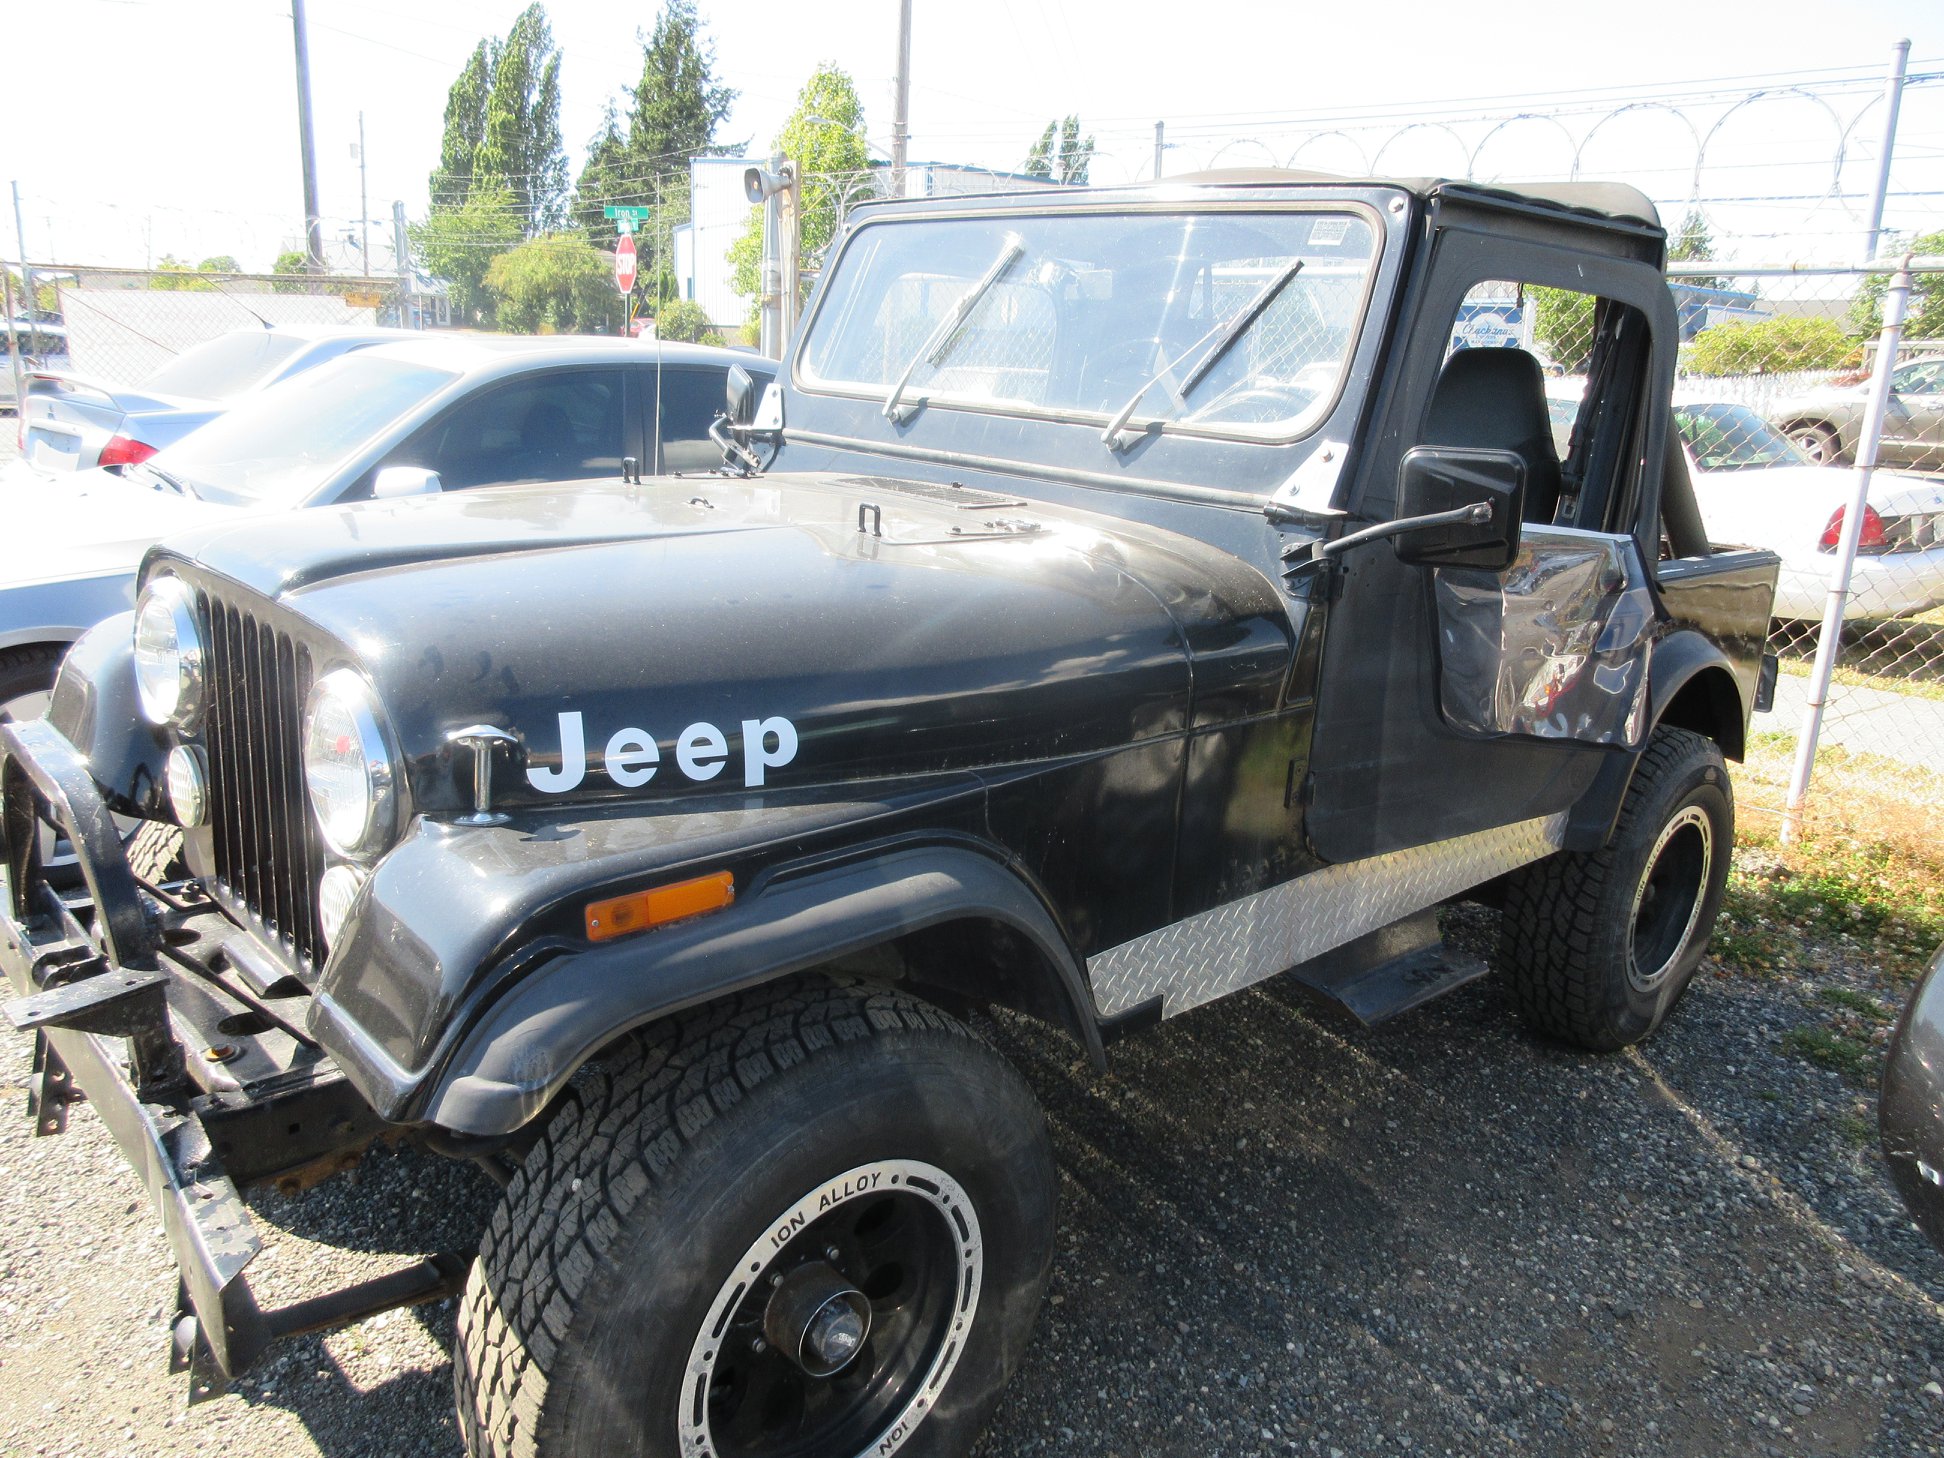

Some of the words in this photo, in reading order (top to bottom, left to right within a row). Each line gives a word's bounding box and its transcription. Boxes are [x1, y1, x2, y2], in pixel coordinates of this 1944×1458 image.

[614, 207, 630, 218] Iron
[617, 253, 635, 275] STOP
[526, 711, 798, 793] Jeep
[771, 1211, 805, 1248] ION
[818, 1171, 882, 1211] ALLOY
[879, 1421, 908, 1455] ION
